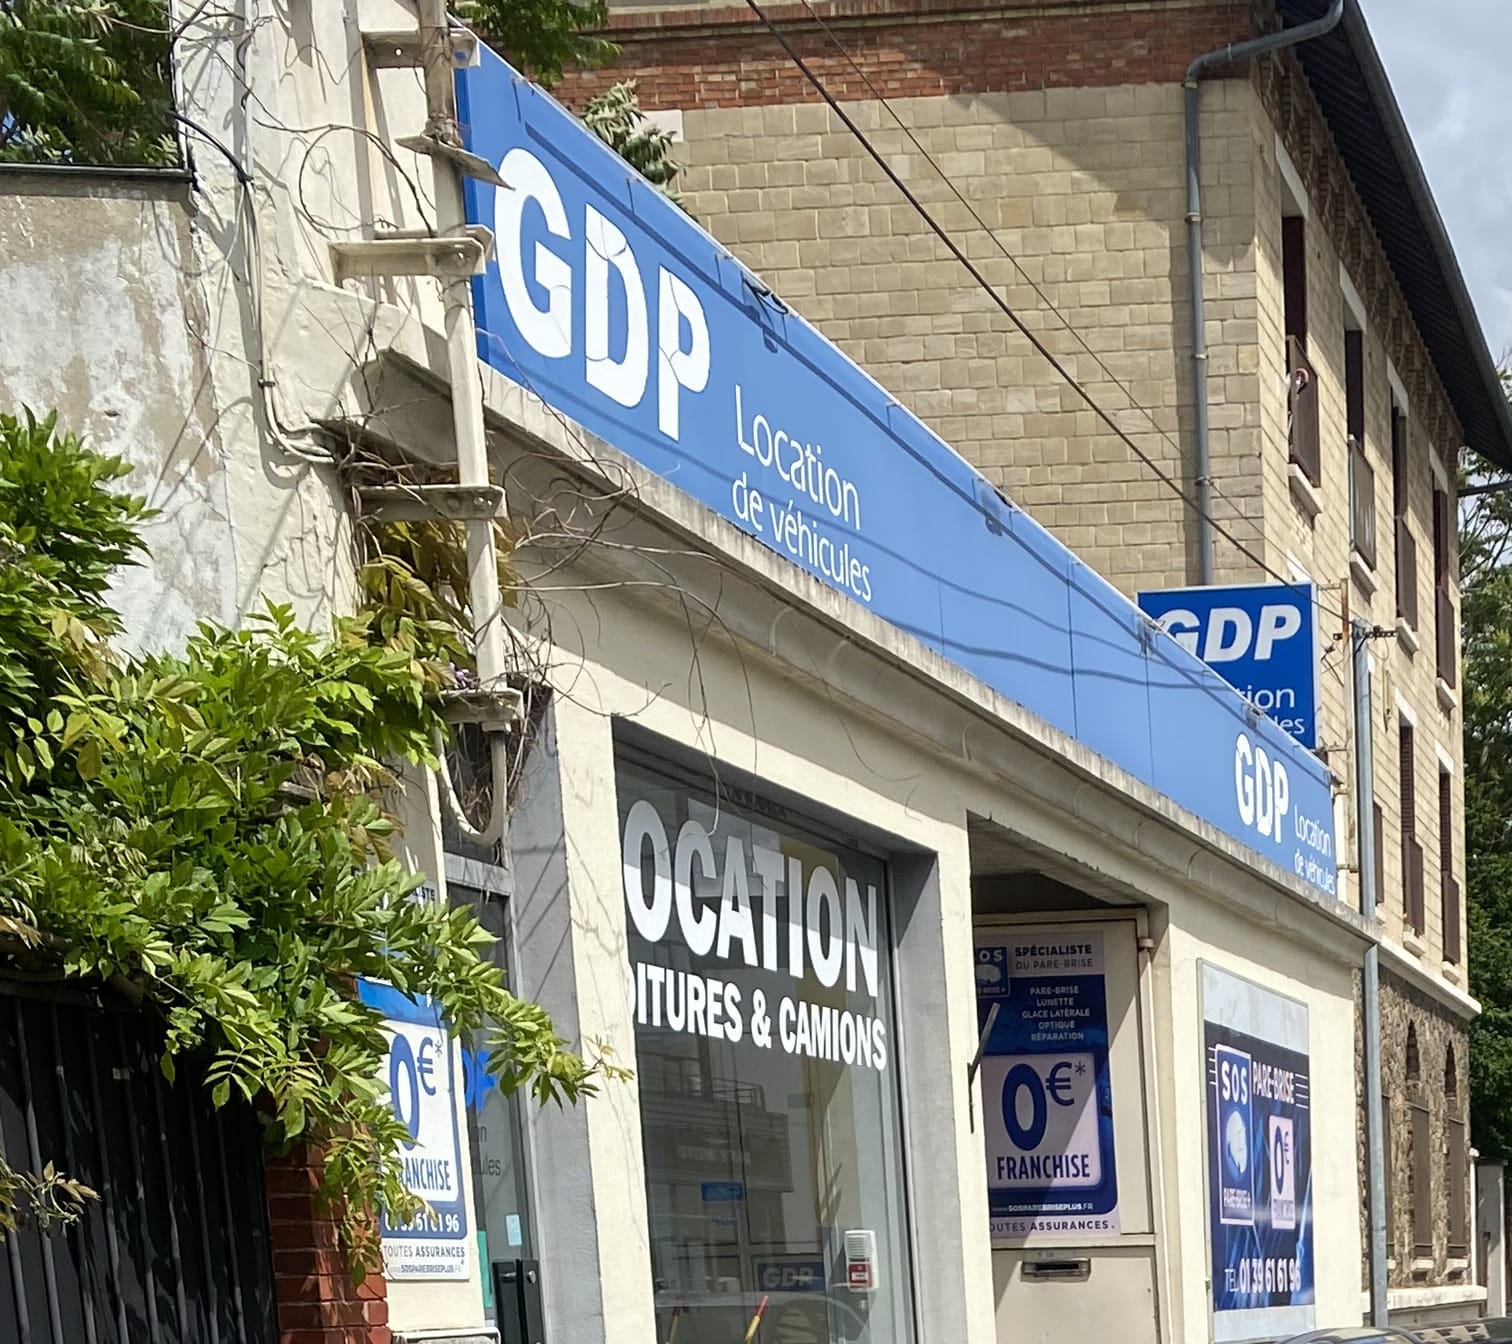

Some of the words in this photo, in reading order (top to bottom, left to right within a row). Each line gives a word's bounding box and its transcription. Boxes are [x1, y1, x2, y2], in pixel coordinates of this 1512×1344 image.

[494, 148, 711, 441] GDP
[734, 384, 861, 531] Location
[731, 472, 764, 538] de
[771, 496, 873, 603] véhicules
[1235, 733, 1289, 843] GDP
[1294, 804, 1332, 858] Location
[1294, 848, 1304, 877] de
[1305, 854, 1335, 896] véhicules
[624, 800, 878, 998] OCATION
[978, 949, 1003, 962] OS
[1015, 944, 1092, 957] SPÉCIALISTE
[1015, 960, 1030, 970] DU
[1033, 958, 1093, 970] PARE-BRISE
[1030, 985, 1079, 996] PARE-BRISE
[1036, 997, 1074, 1007] LUNETTE
[628, 962, 743, 1043] ITURES
[751, 988, 772, 1048] &
[779, 996, 887, 1070] CAMIONS
[1022, 1009, 1049, 1019] GLACE
[1050, 1007, 1090, 1018] LATÉRALE
[1030, 1032, 1084, 1042] RÉPARATION
[1038, 1020, 1075, 1031] OPTIQUE
[1221, 1060, 1249, 1106] SOS
[1253, 1060, 1295, 1105] PARE-BRISE
[400, 1157, 451, 1190] ANCHISE
[996, 1153, 1090, 1180] FRANCHISE
[445, 1213, 460, 1233] 96
[990, 1222, 1026, 1233] OUTES
[1030, 1219, 1109, 1231] ASSURANCES
[383, 1244, 413, 1258] TOUTES
[415, 1246, 465, 1258] ASSURANCES
